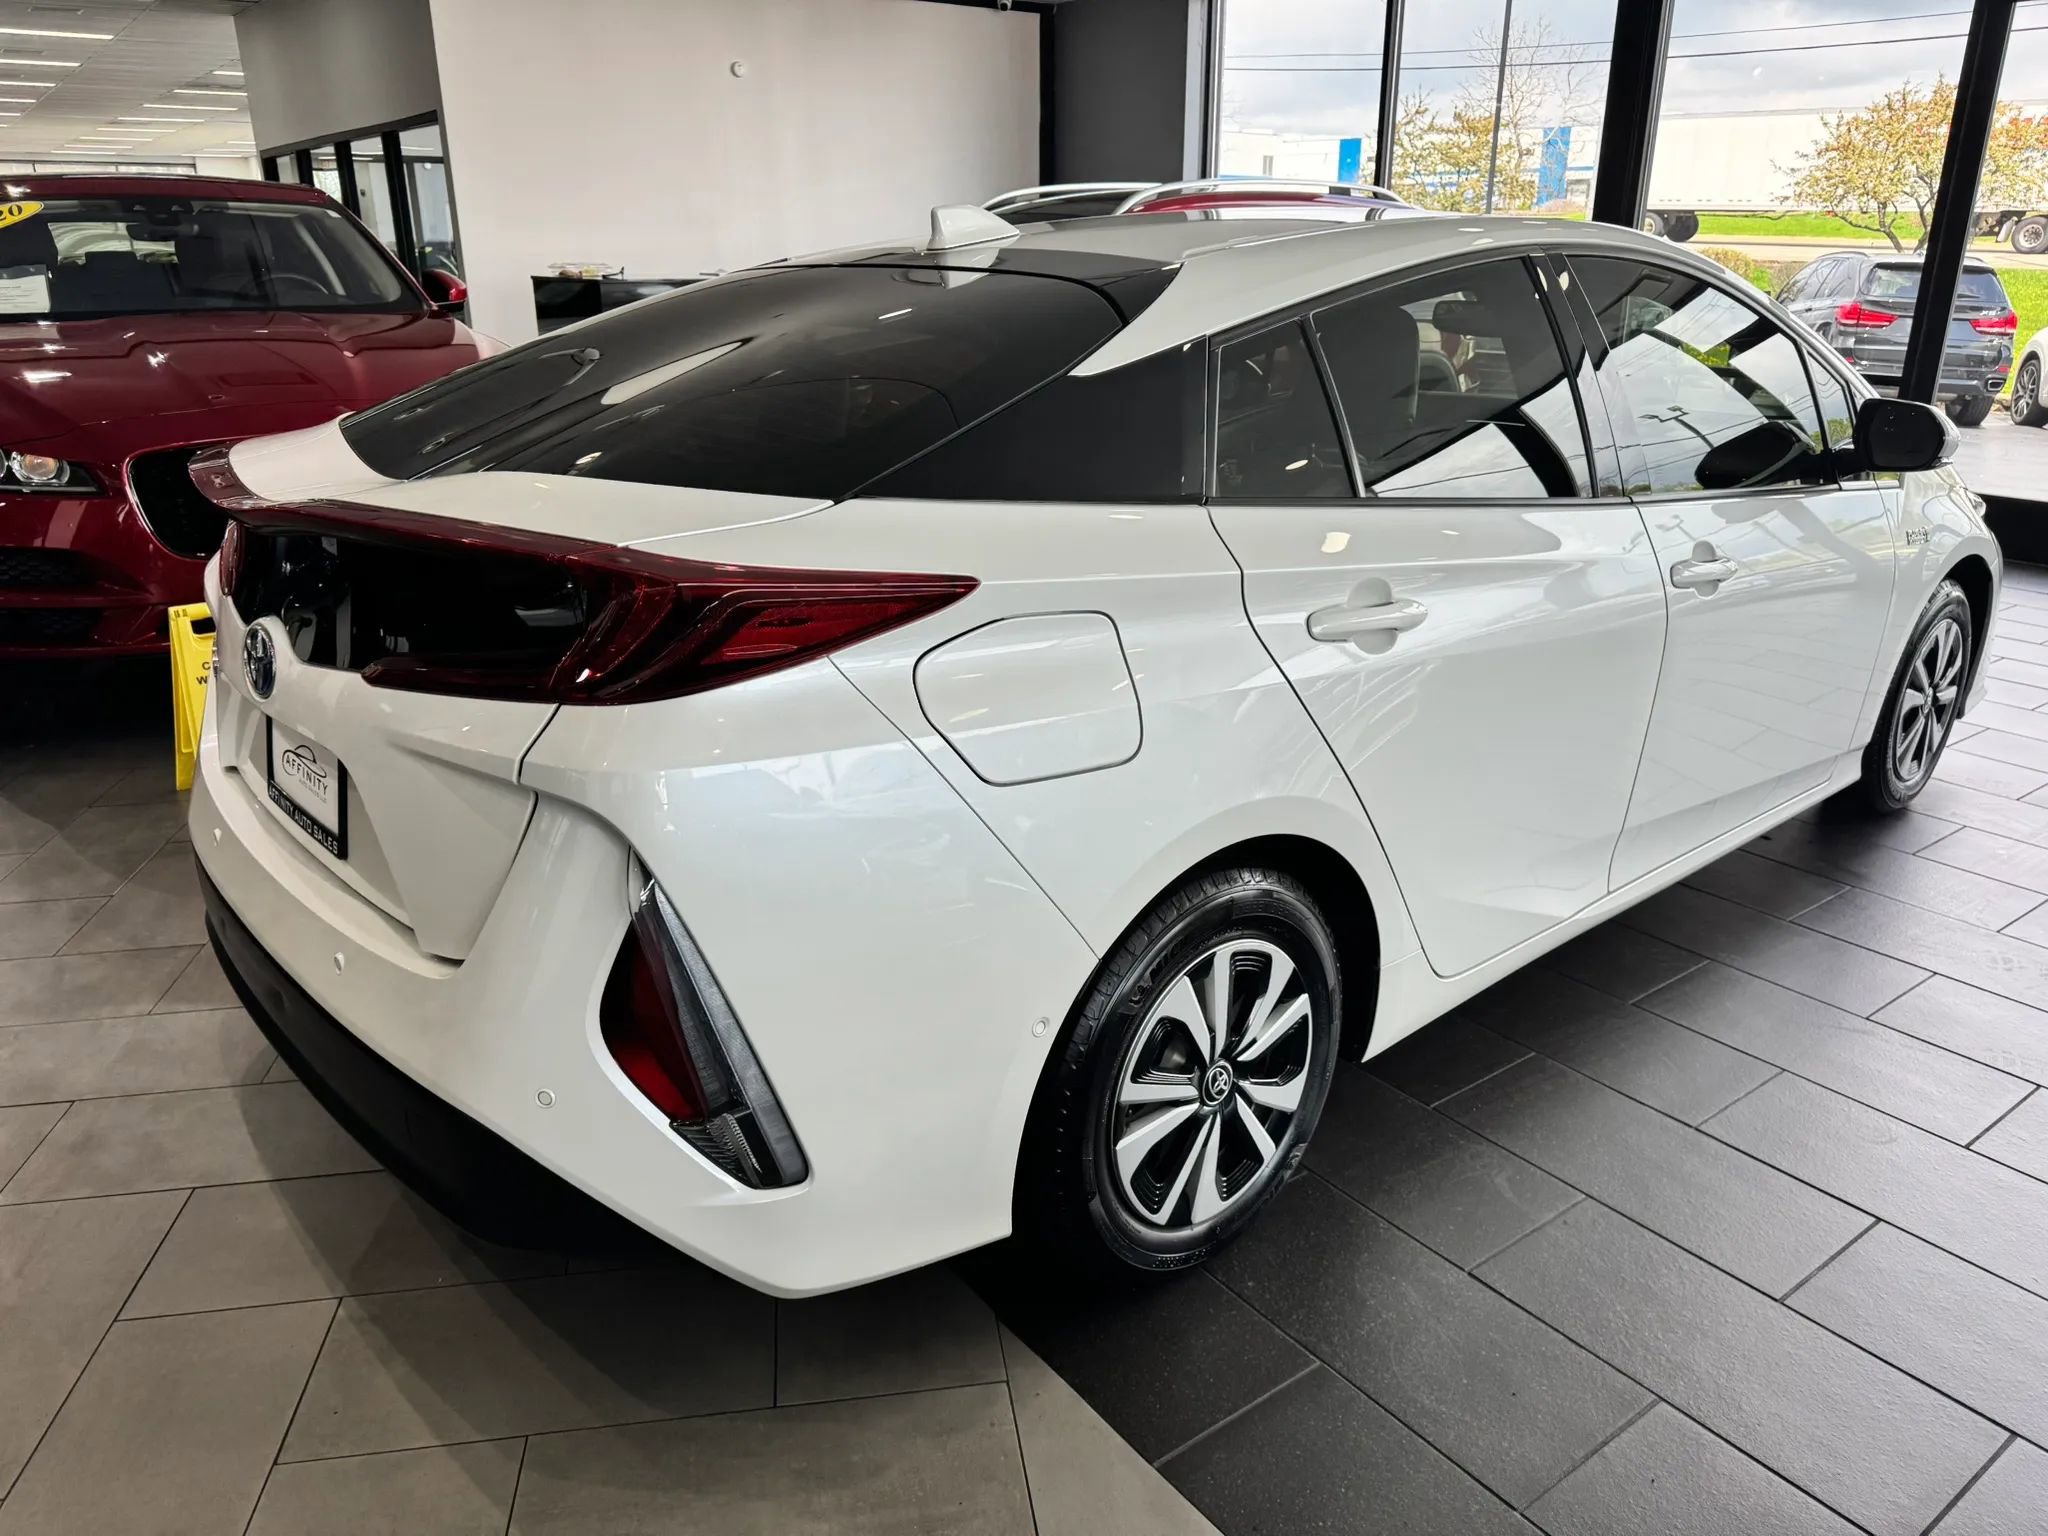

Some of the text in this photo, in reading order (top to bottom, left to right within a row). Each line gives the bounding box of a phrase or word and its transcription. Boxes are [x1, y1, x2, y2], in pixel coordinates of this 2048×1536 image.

[285, 754, 328, 795] AFFINITY
[269, 784, 294, 815] AFFINITY
[294, 811, 312, 833] AUTO
[313, 825, 338, 854] SALES
